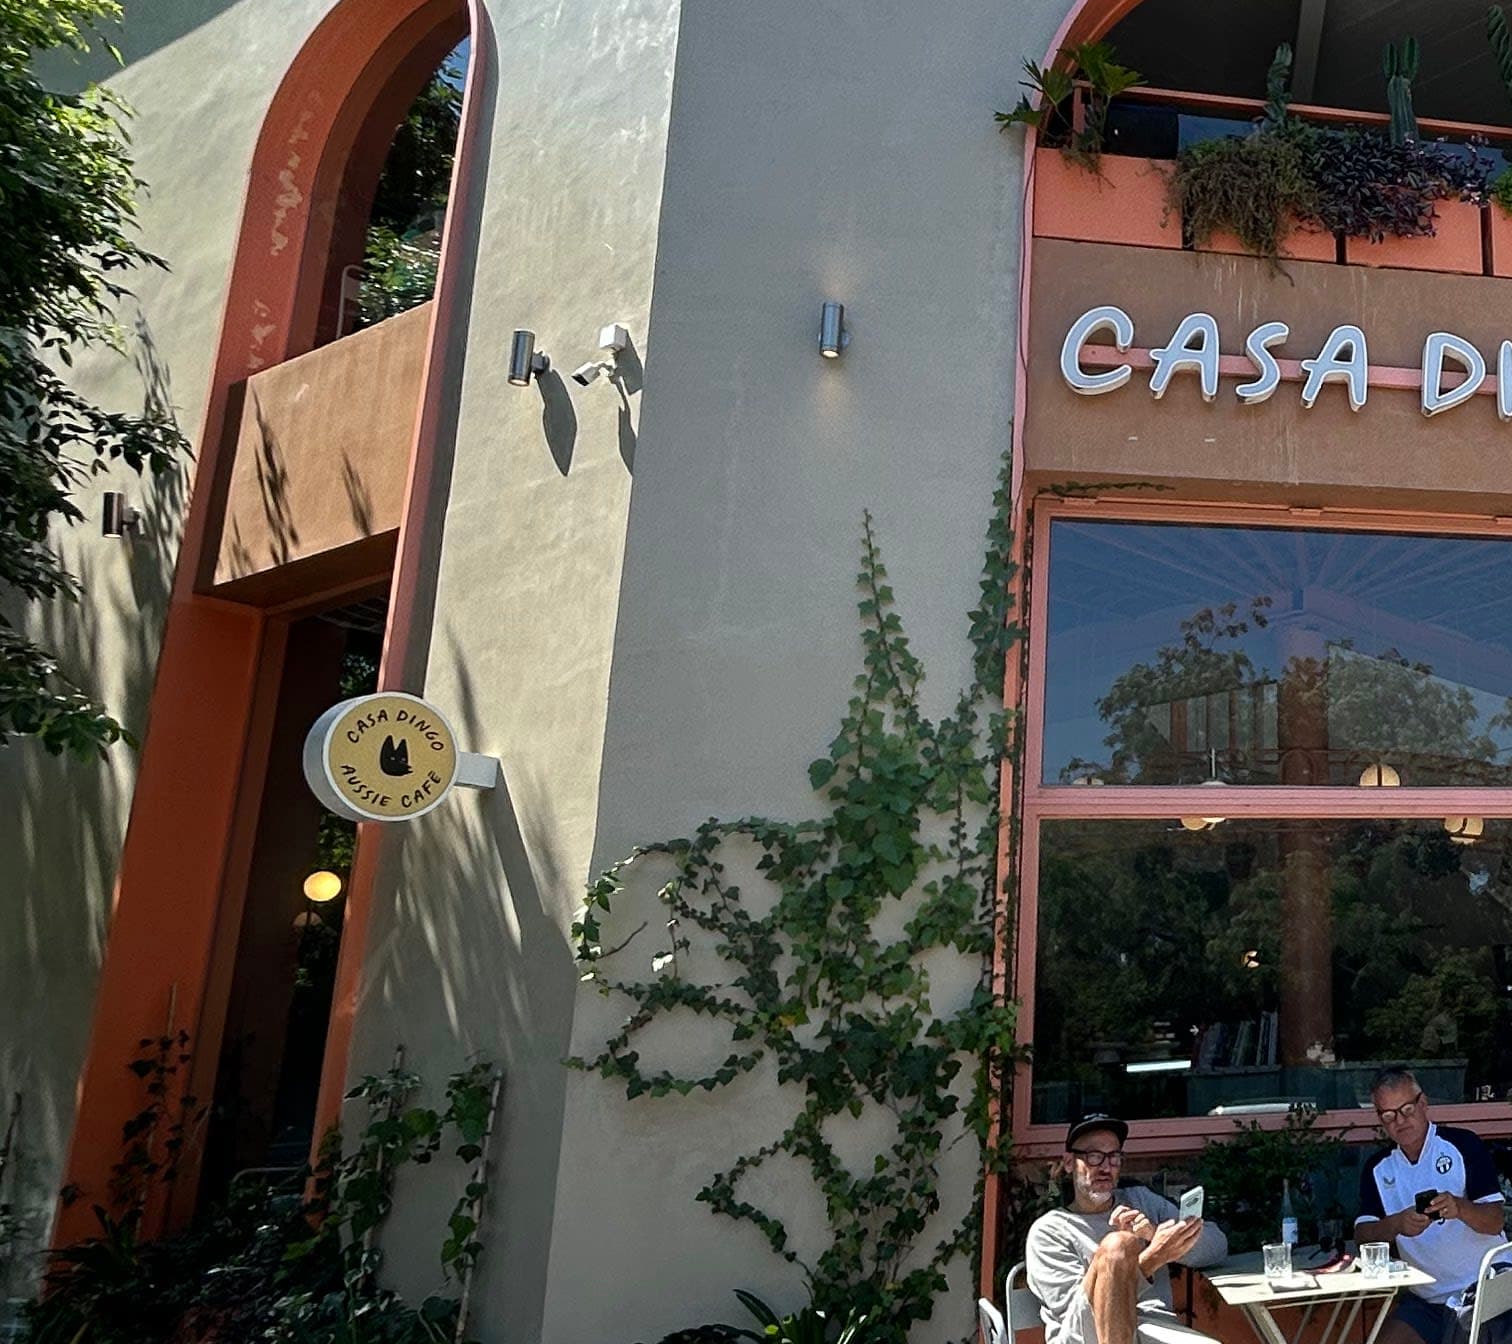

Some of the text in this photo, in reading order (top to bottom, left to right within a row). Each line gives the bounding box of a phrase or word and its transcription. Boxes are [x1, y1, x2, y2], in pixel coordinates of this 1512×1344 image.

[1060, 305, 1369, 412] CASA
[347, 709, 444, 751] CASA DINGO
[340, 764, 392, 806] AUSSIE
